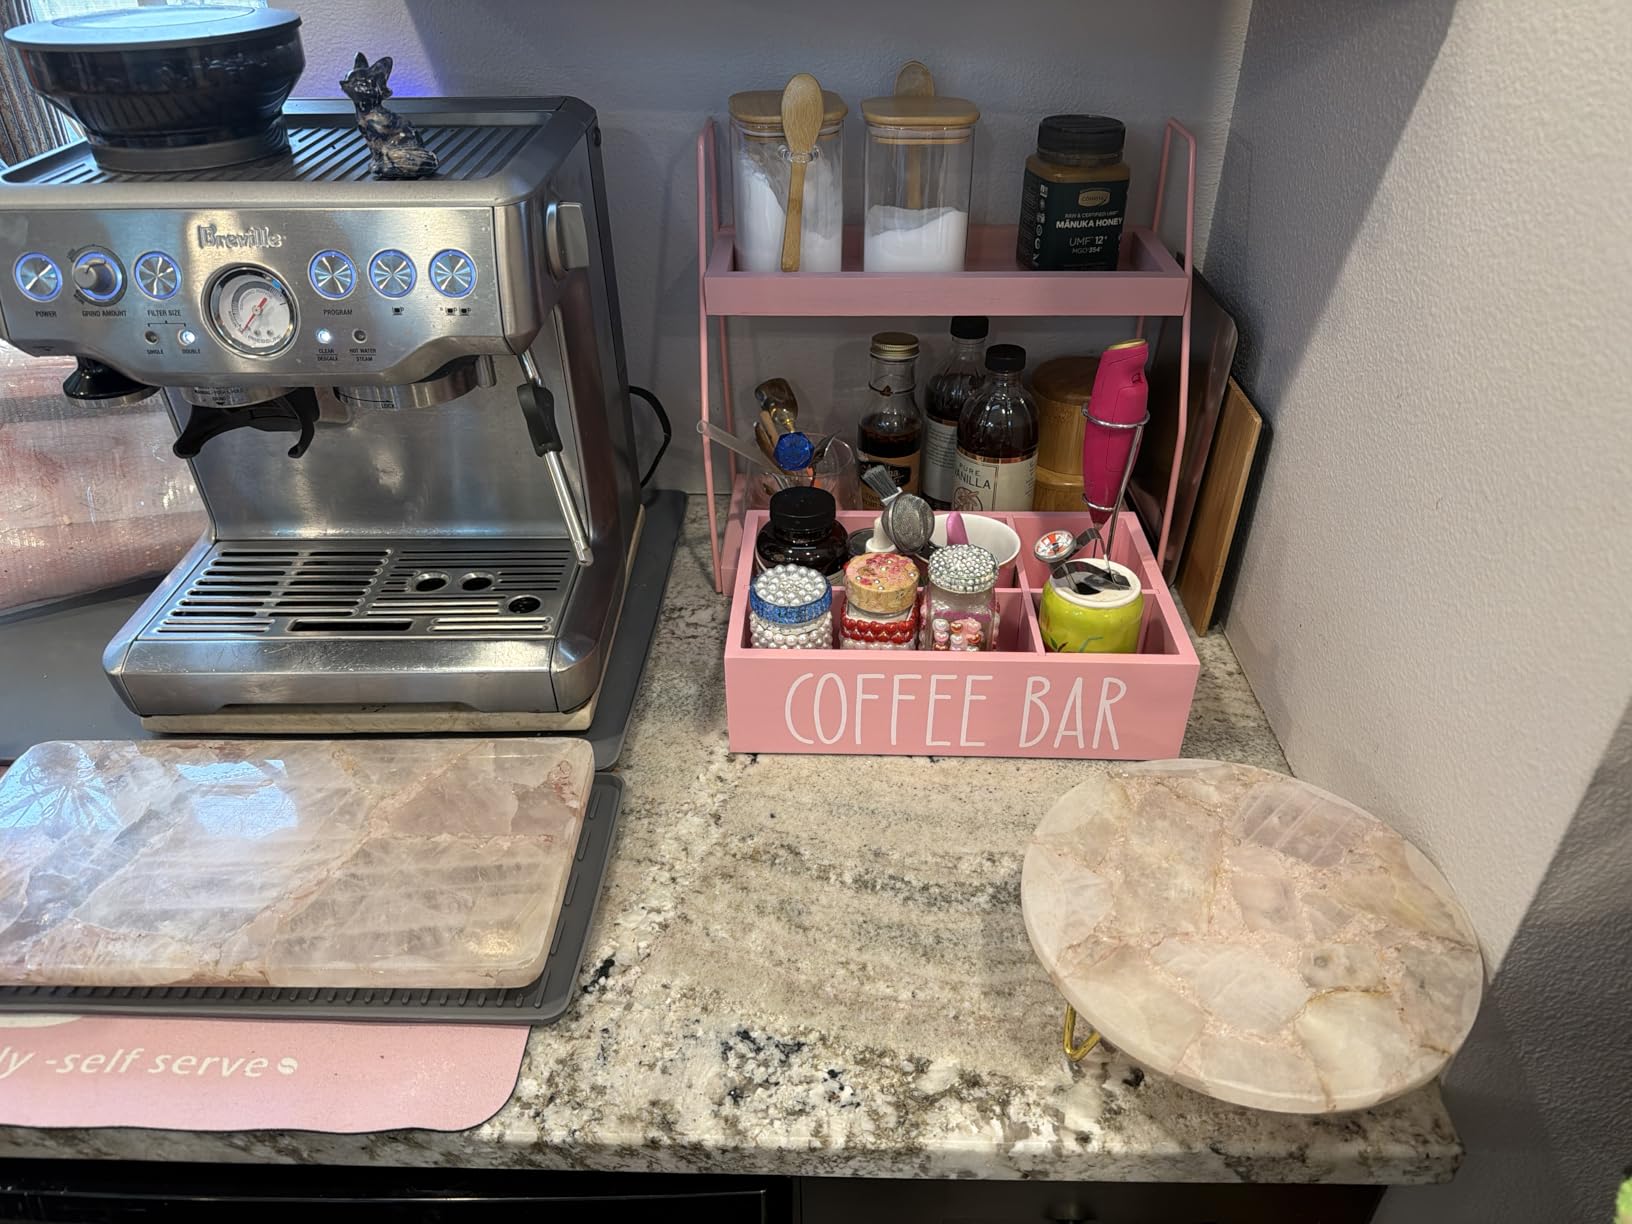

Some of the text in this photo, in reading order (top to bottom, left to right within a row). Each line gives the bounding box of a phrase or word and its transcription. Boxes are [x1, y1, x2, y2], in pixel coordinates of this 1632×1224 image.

[1096, 217, 1123, 227] HONEY
[35, 310, 57, 318] POWER
[82, 309, 127, 318] GRIND AMOUNT
[147, 309, 182, 317] FILTER SIZE
[959, 462, 981, 477] PURE
[784, 672, 1127, 751] COFFEE BAR
[147, 1053, 270, 1078] serve
